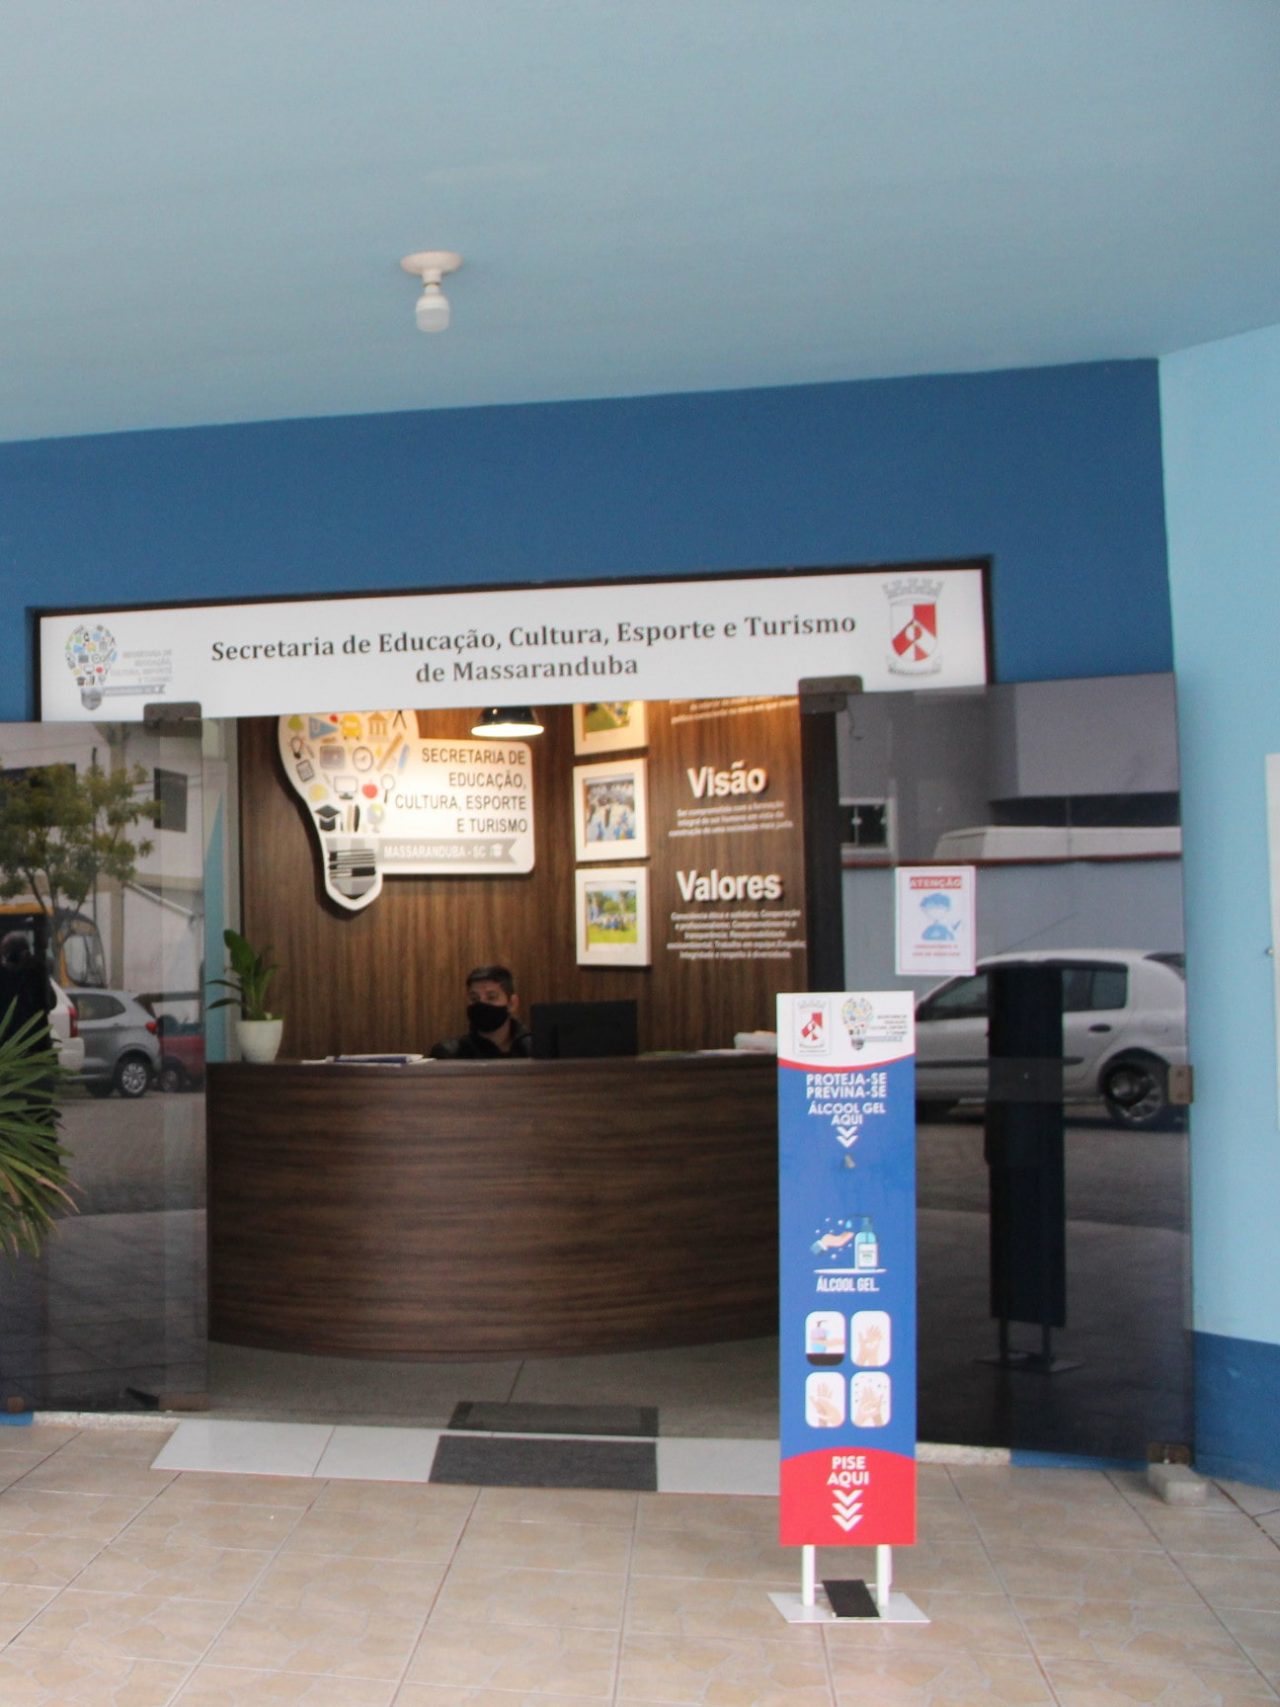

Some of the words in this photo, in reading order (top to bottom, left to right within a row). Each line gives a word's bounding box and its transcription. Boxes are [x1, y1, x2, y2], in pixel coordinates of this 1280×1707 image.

[211, 636, 334, 661] Secretaria
[342, 634, 370, 654] de
[378, 629, 502, 655] Educação,
[509, 625, 609, 647] Cultura,
[617, 620, 715, 646] Esporte
[724, 623, 737, 638] e
[744, 614, 856, 636] Turismo
[416, 663, 445, 682] de
[453, 655, 638, 681] Massaranduba
[422, 748, 505, 764] SECRETARIA
[509, 751, 526, 764] DE
[449, 770, 527, 790] EDUCAÇÃO,
[687, 760, 767, 798] Visão
[395, 794, 462, 811] CULTURA,
[466, 795, 527, 810] ESPORTE
[457, 818, 465, 832] E
[470, 818, 528, 833] TURISMO
[676, 869, 784, 901] Valores
[806, 1072, 887, 1087] PROTEJA-SE
[806, 1085, 887, 1099] PREVINA-SE
[808, 1101, 859, 1115] ÁLCOOL
[862, 1102, 886, 1114] GEL
[831, 1114, 863, 1126] AQUI
[816, 1275, 855, 1292] ÁLCOOL
[832, 1455, 865, 1470] PISE
[827, 1471, 869, 1488] AQUI
